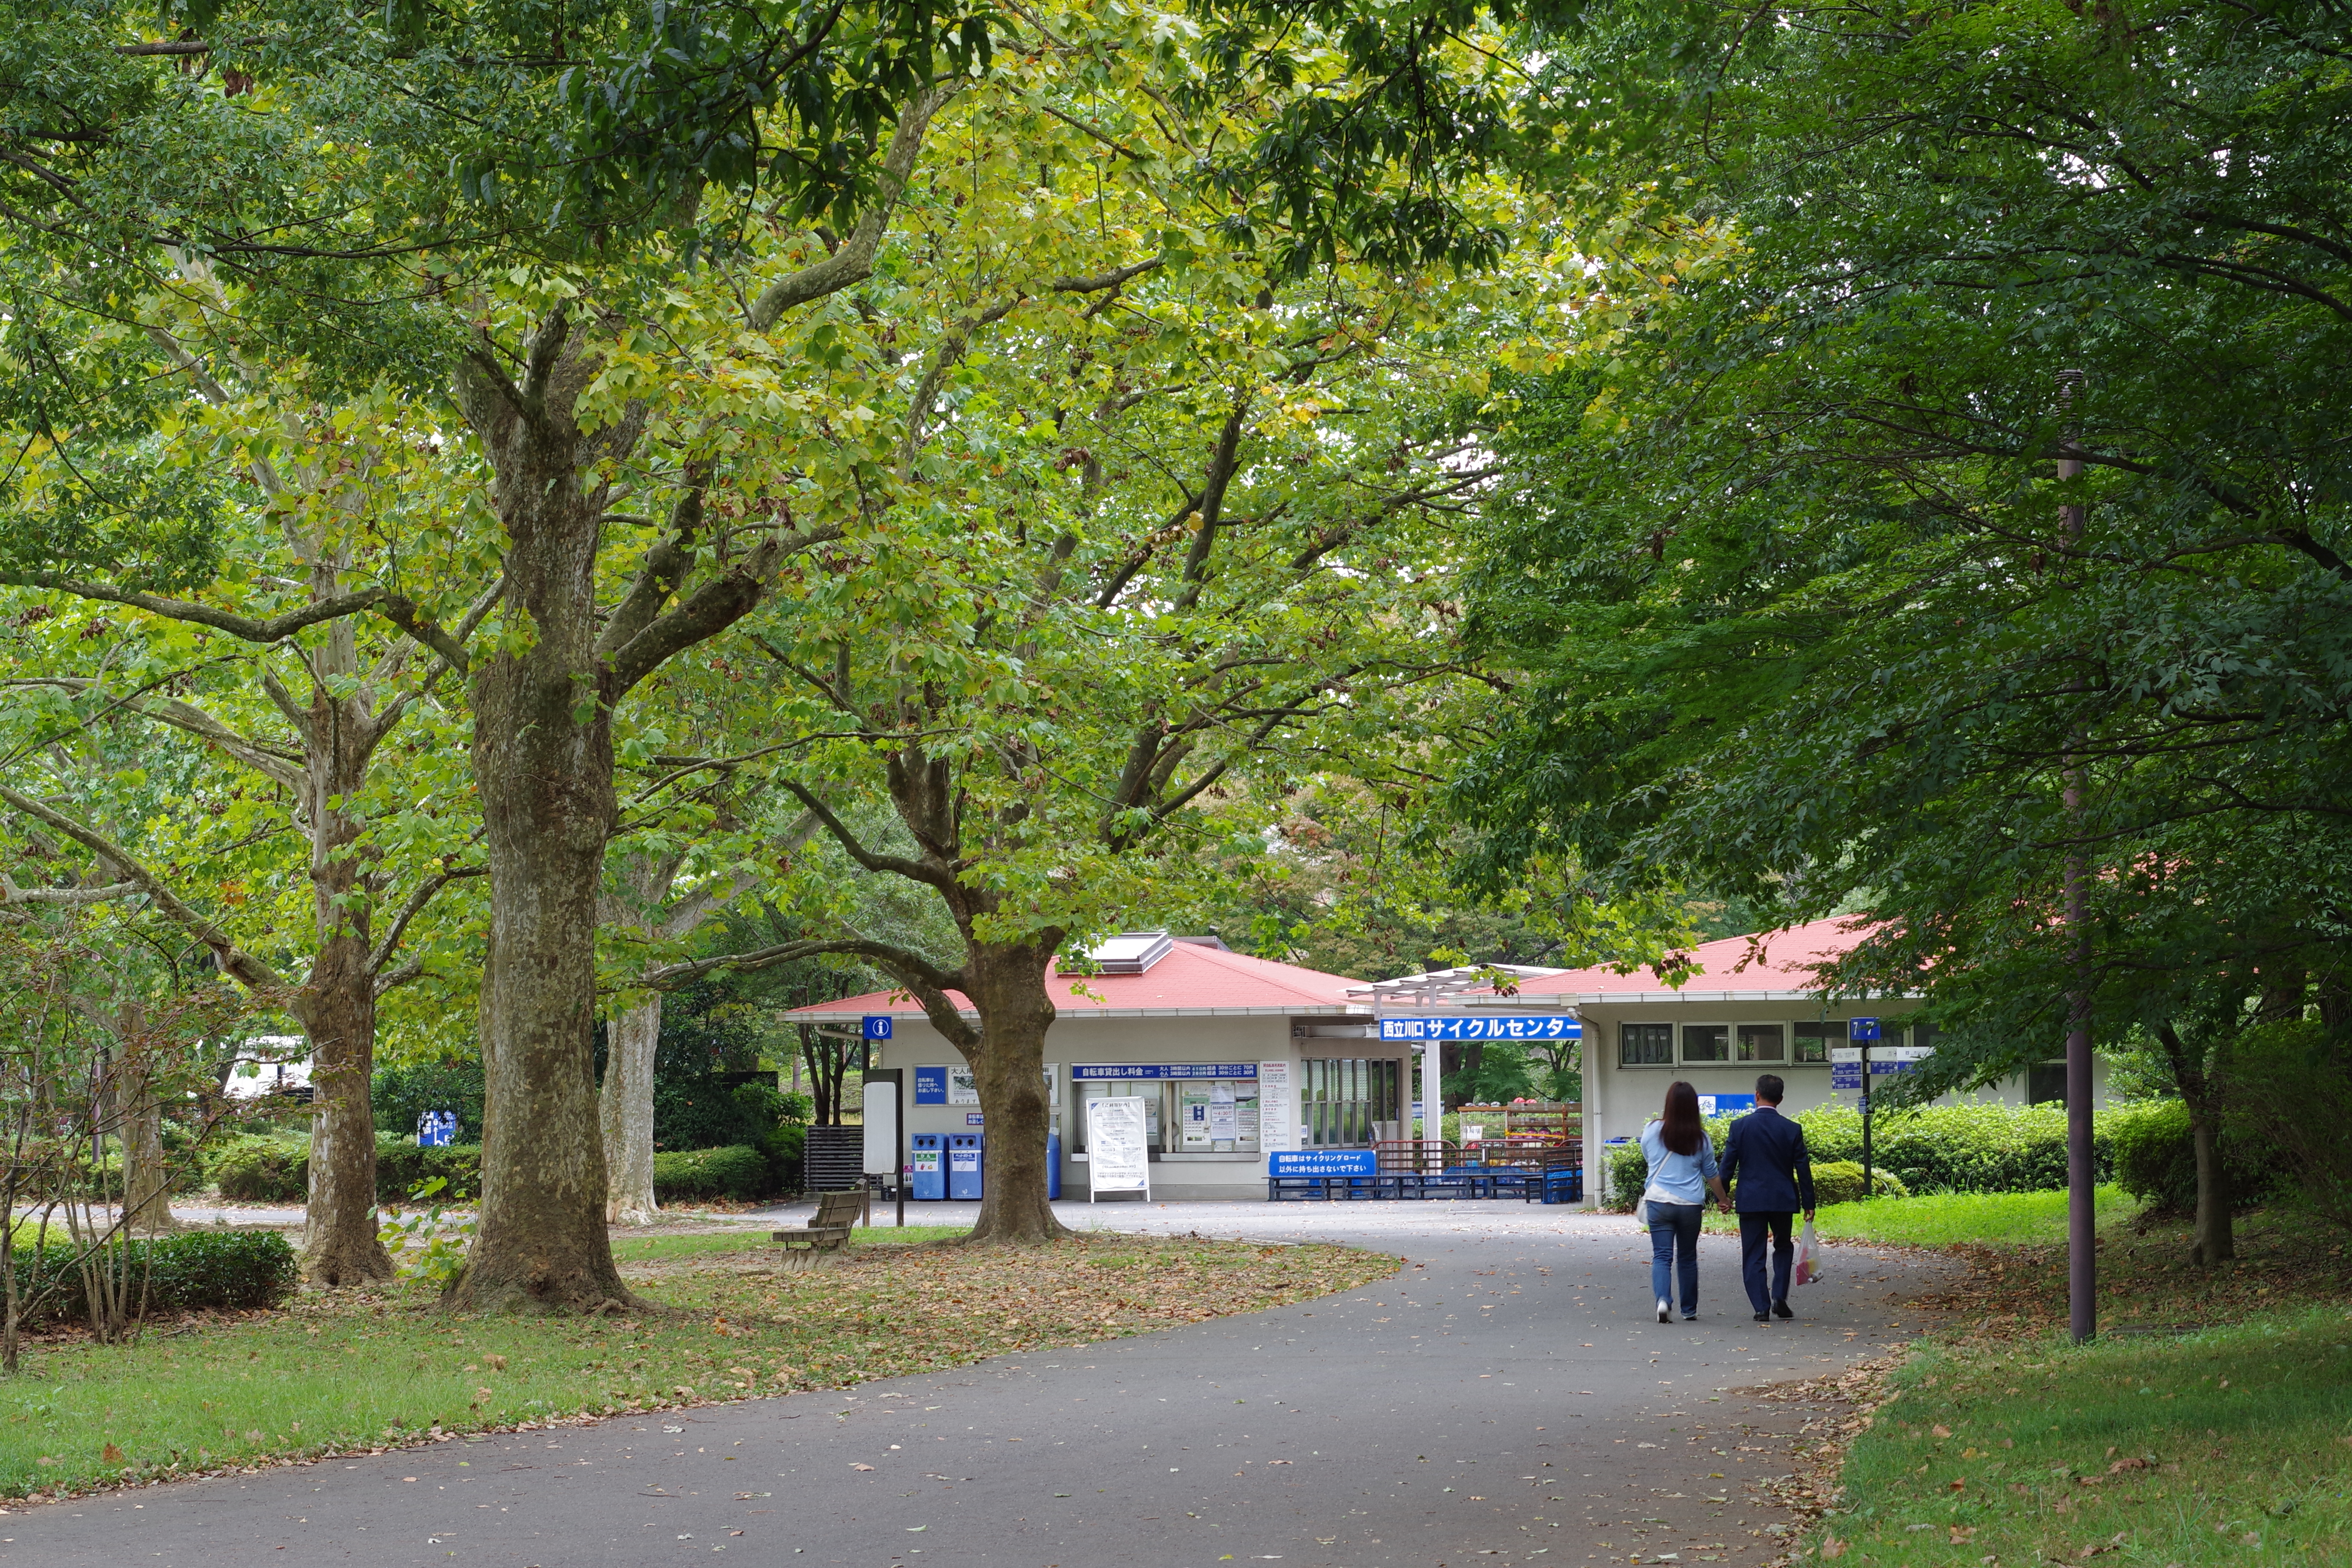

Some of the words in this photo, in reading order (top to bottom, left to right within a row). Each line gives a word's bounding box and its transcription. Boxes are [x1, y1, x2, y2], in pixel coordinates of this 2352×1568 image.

[1383, 1021, 1424, 1038] 西立川口
[1427, 1018, 1582, 1038] サイクルセンター
[1853, 1022, 1858, 1035] 7
[1866, 1021, 1874, 1035] 7
[1082, 1067, 1144, 1077] 自転車貸出し料金
[1279, 1165, 1366, 1173] 以外に持ち出さないで下さい
